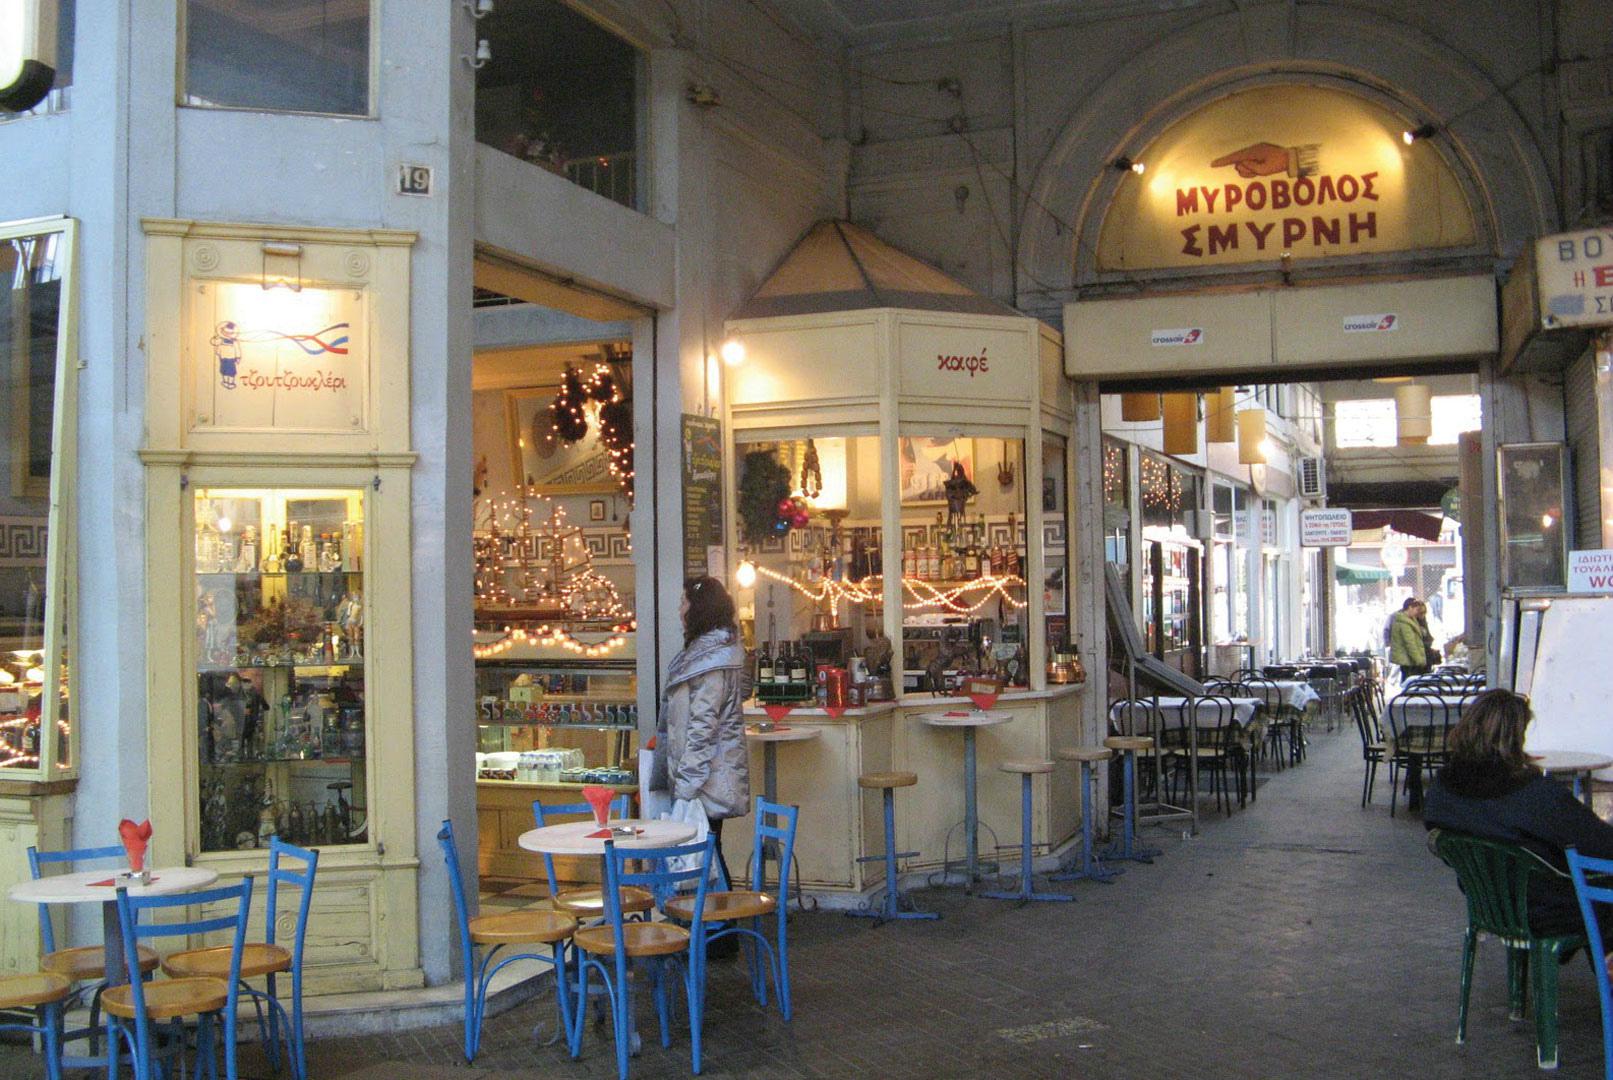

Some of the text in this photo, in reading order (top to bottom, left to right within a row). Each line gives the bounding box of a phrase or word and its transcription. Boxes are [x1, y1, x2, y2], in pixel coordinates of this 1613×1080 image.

[401, 168, 429, 190] 19
[1176, 171, 1380, 217] ΜΥΡΟΒΟΛΟΣ
[1180, 211, 1378, 258] ΣΜΥΡΝΗ
[1558, 233, 1613, 262] ΒΟ
[1594, 295, 1613, 314] Σ
[1152, 333, 1185, 344] crossair
[937, 347, 989, 378] καφέ
[1573, 565, 1613, 574] ΤΟΥΑΛ
